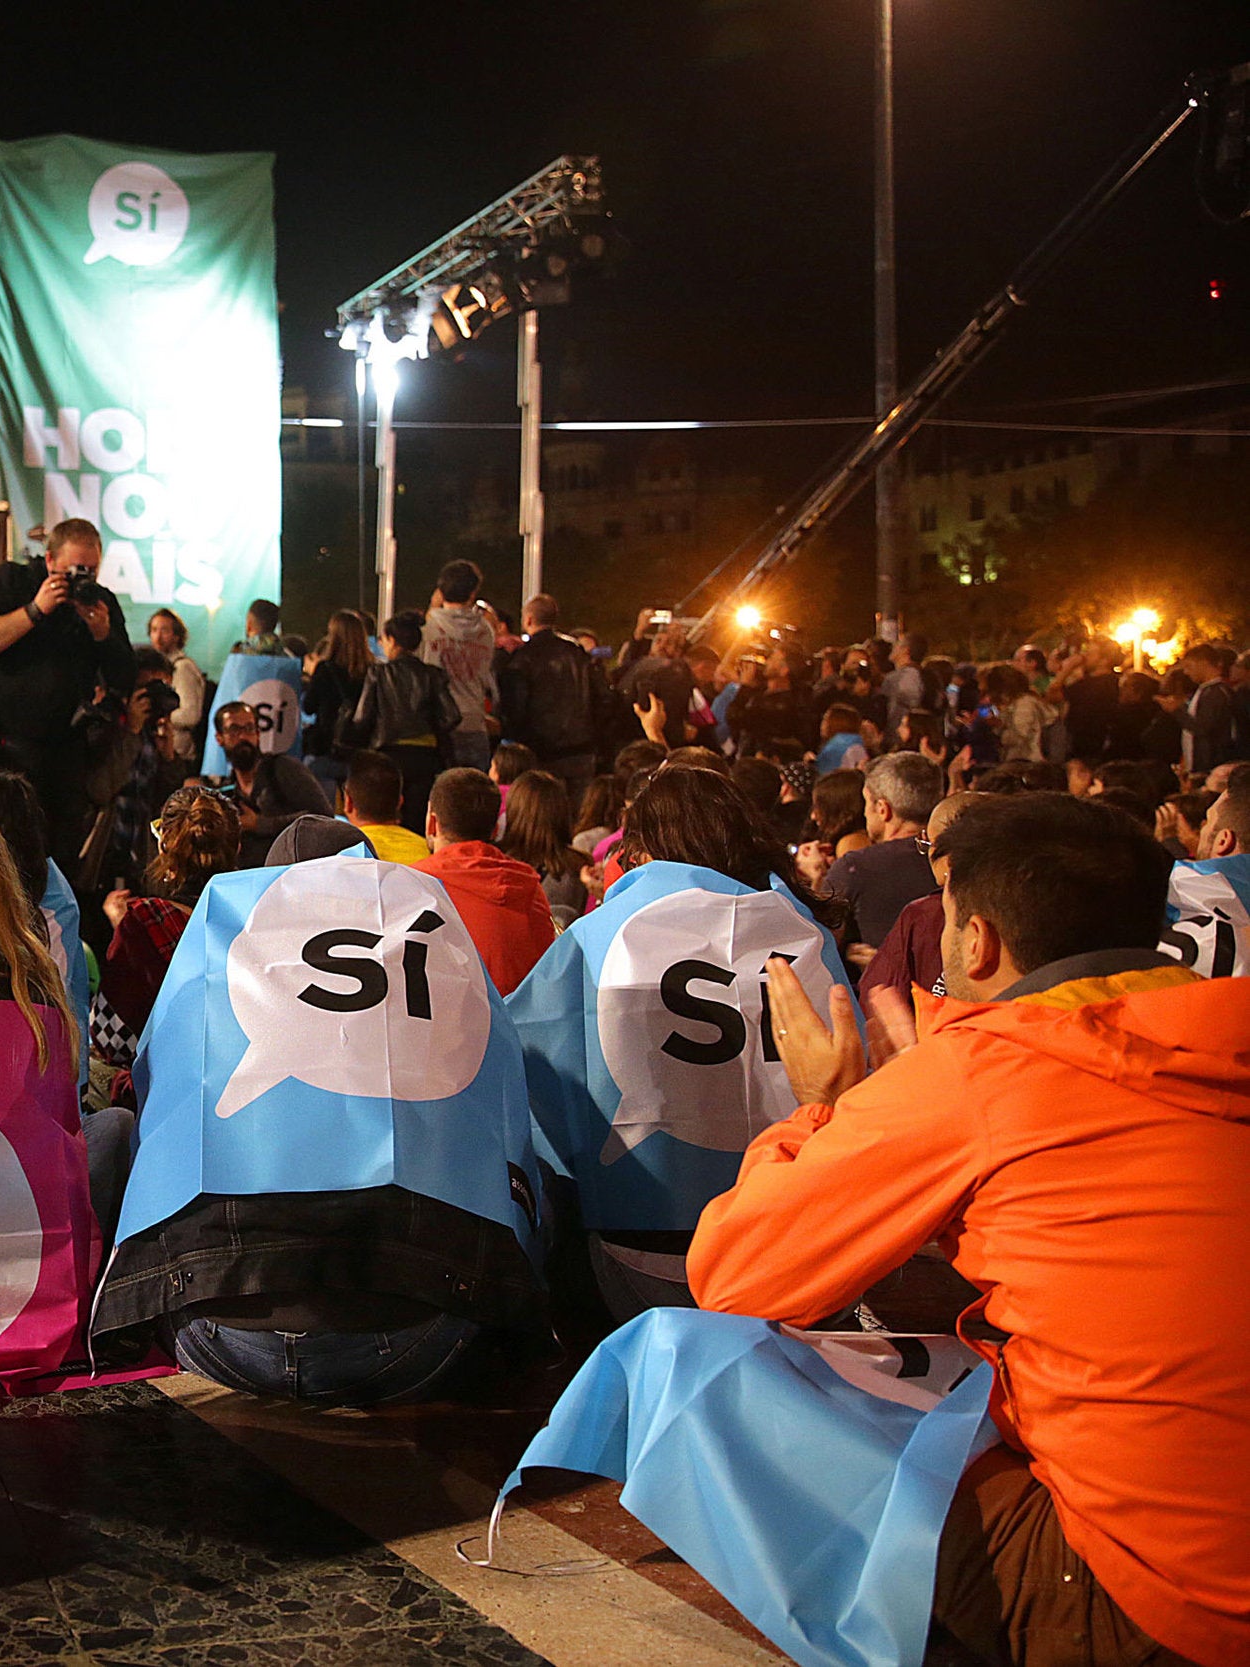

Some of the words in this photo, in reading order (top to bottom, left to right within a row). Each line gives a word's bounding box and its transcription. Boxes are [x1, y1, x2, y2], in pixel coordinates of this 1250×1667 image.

[113, 189, 159, 231] Sí
[98, 530, 225, 606] AÍS
[256, 700, 288, 734] Sí
[297, 909, 447, 1021] Sí
